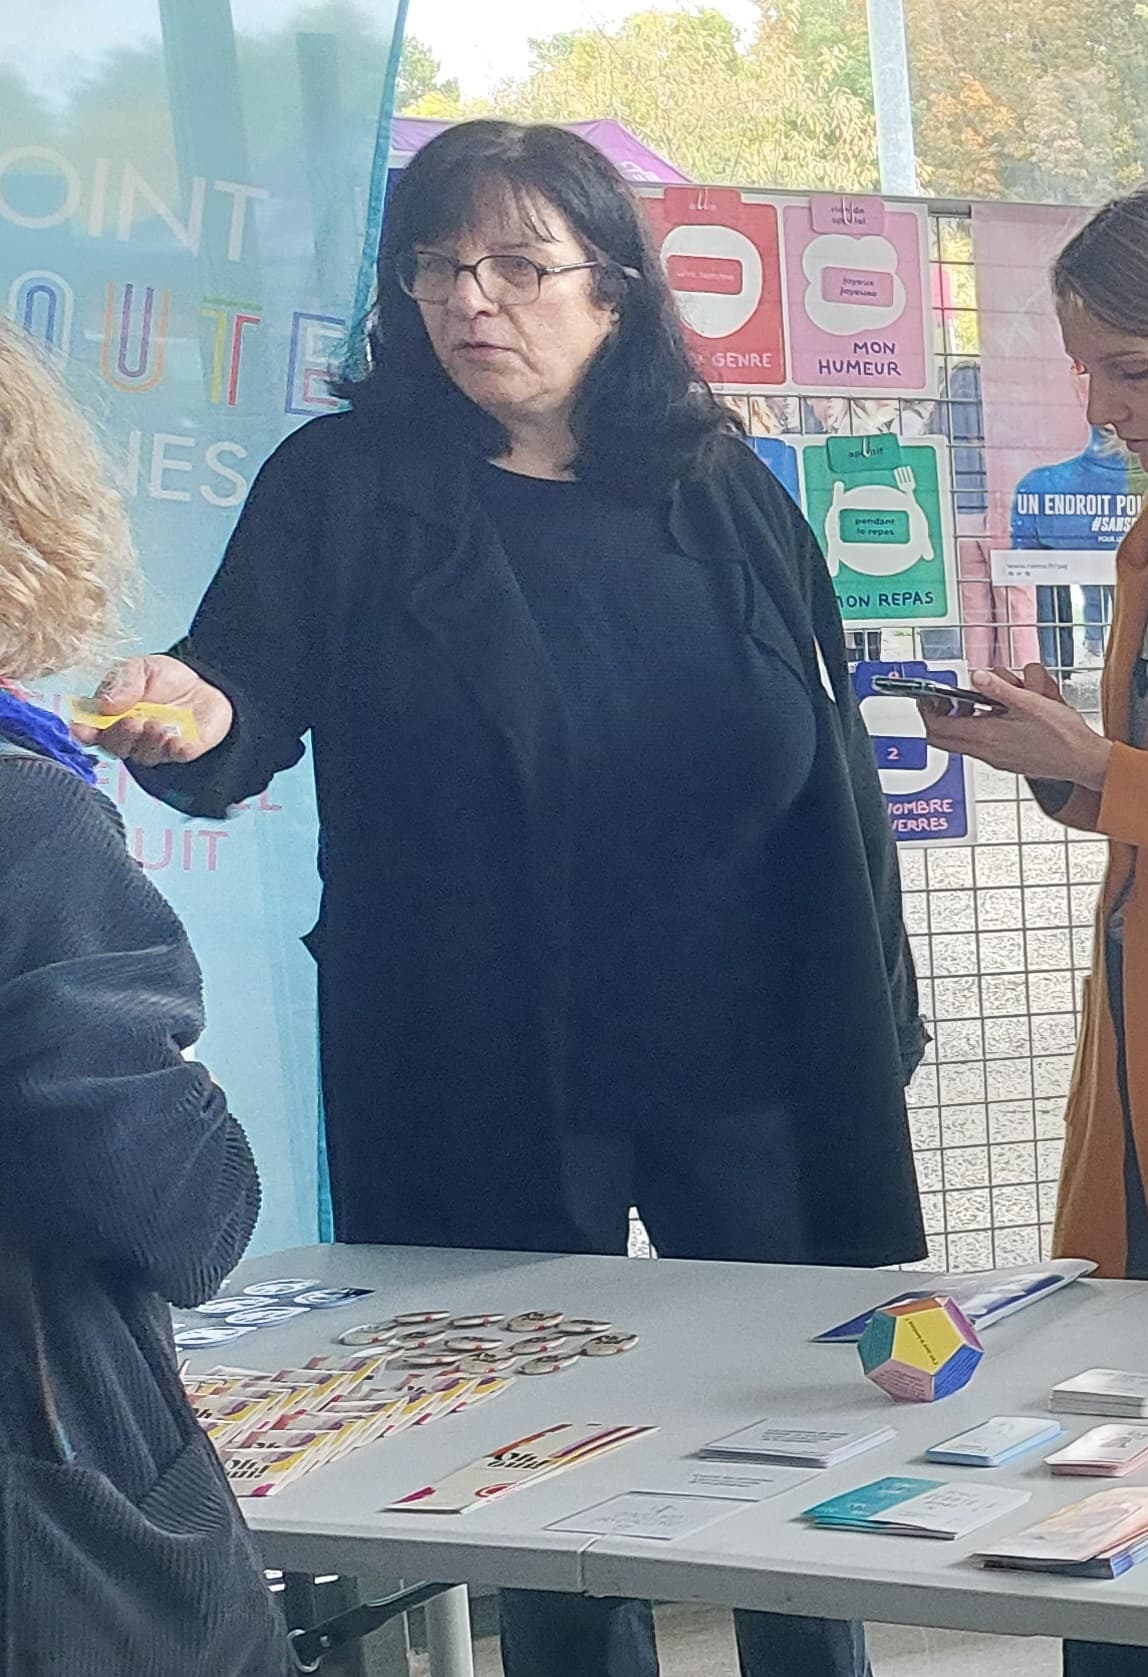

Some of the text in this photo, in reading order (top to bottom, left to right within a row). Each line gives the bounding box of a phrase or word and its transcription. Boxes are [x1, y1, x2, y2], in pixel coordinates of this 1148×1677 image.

[854, 341, 895, 355] MON
[712, 352, 772, 368] GENRE
[819, 358, 902, 376] HUMEUR
[1018, 494, 1039, 515] UN
[1045, 494, 1112, 516] ENDROIT
[855, 517, 895, 527] pendant
[868, 529, 895, 537] repas
[879, 591, 934, 607] REPAS
[887, 748, 900, 760] 2
